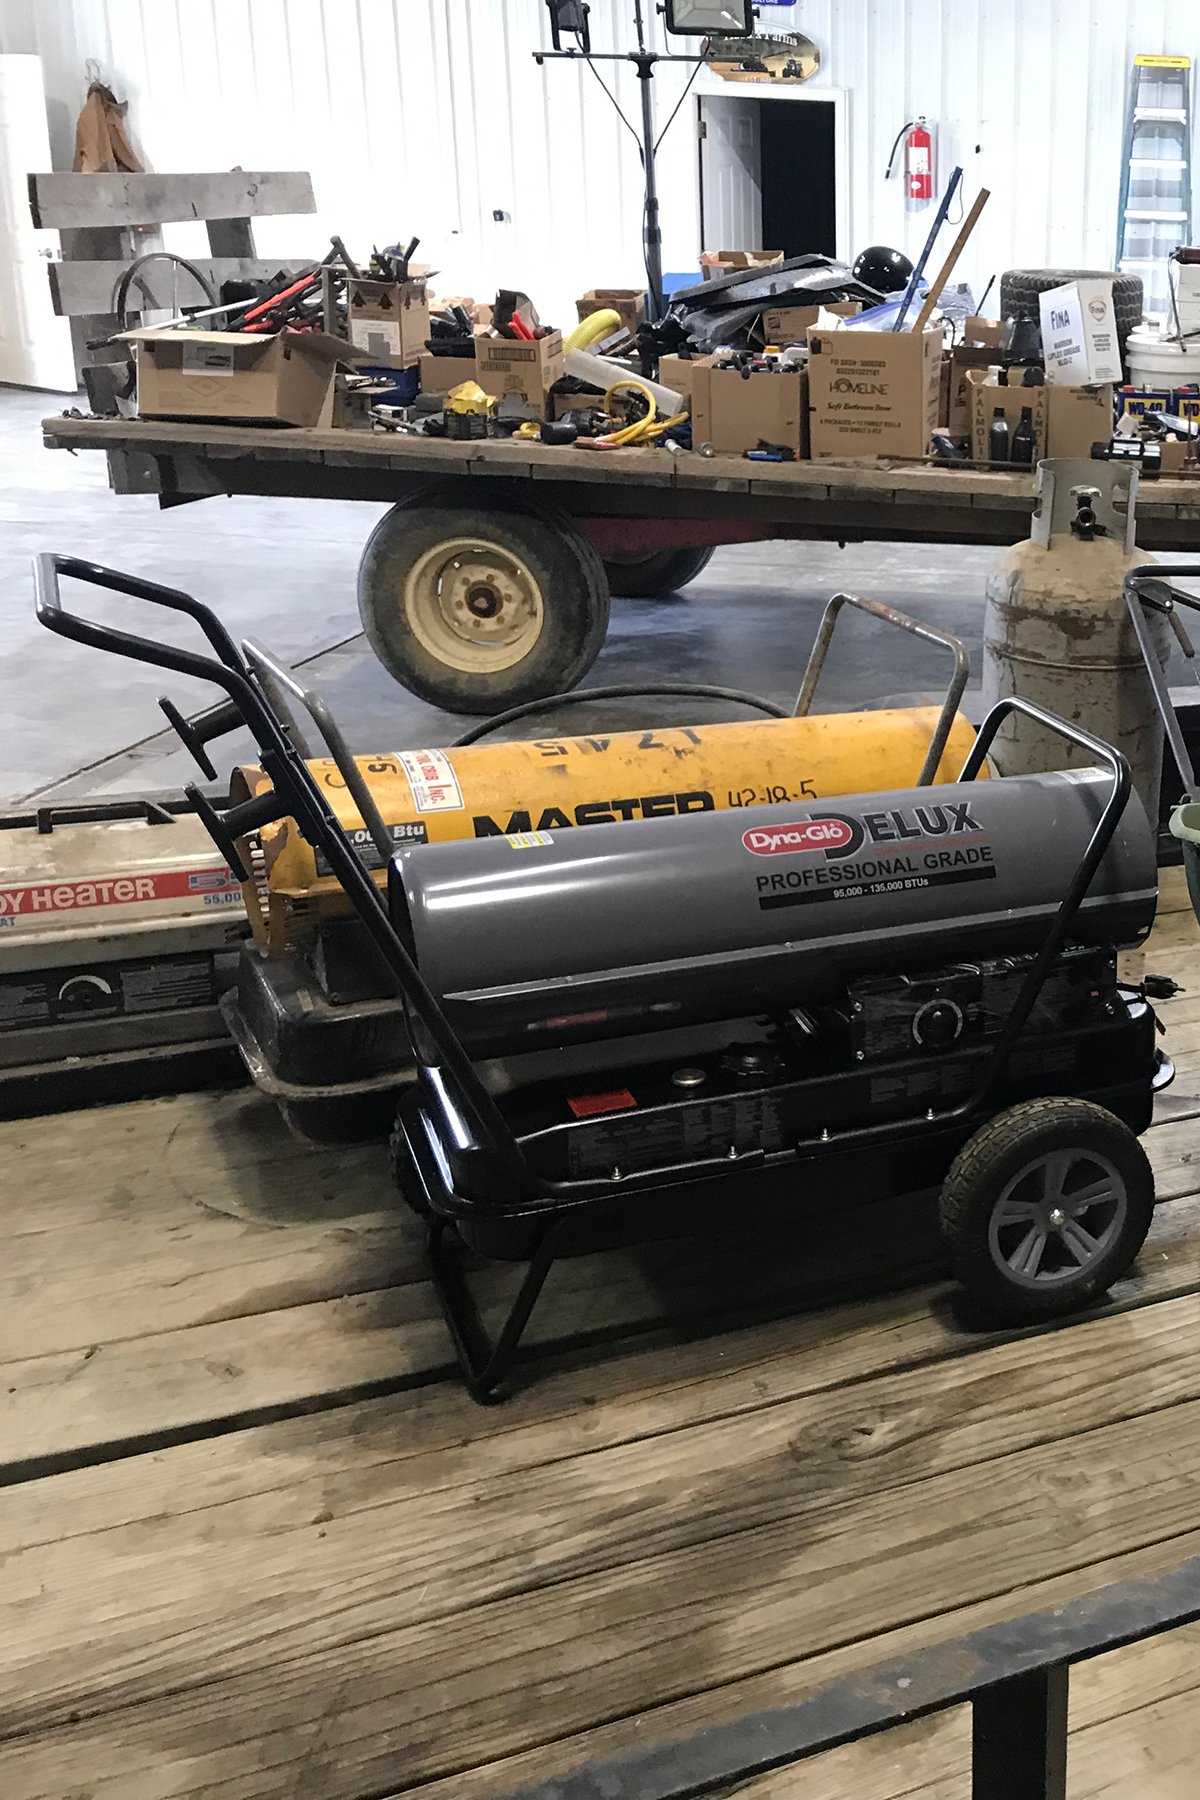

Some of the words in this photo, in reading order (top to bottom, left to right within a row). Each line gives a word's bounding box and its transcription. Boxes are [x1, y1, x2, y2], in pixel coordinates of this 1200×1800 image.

[1050, 309, 1071, 331] FINA
[829, 378, 889, 395] HOMELINE
[1128, 401, 1163, 416] WD-40
[472, 791, 716, 838] MASTER
[393, 824, 425, 839] Btu
[756, 857, 919, 893] PROFESSIONAL
[923, 846, 994, 870] GRADE
[832, 886, 863, 899] 95,000
[904, 878, 930, 890] BTUs
[203, 892, 242, 905] 55,00
